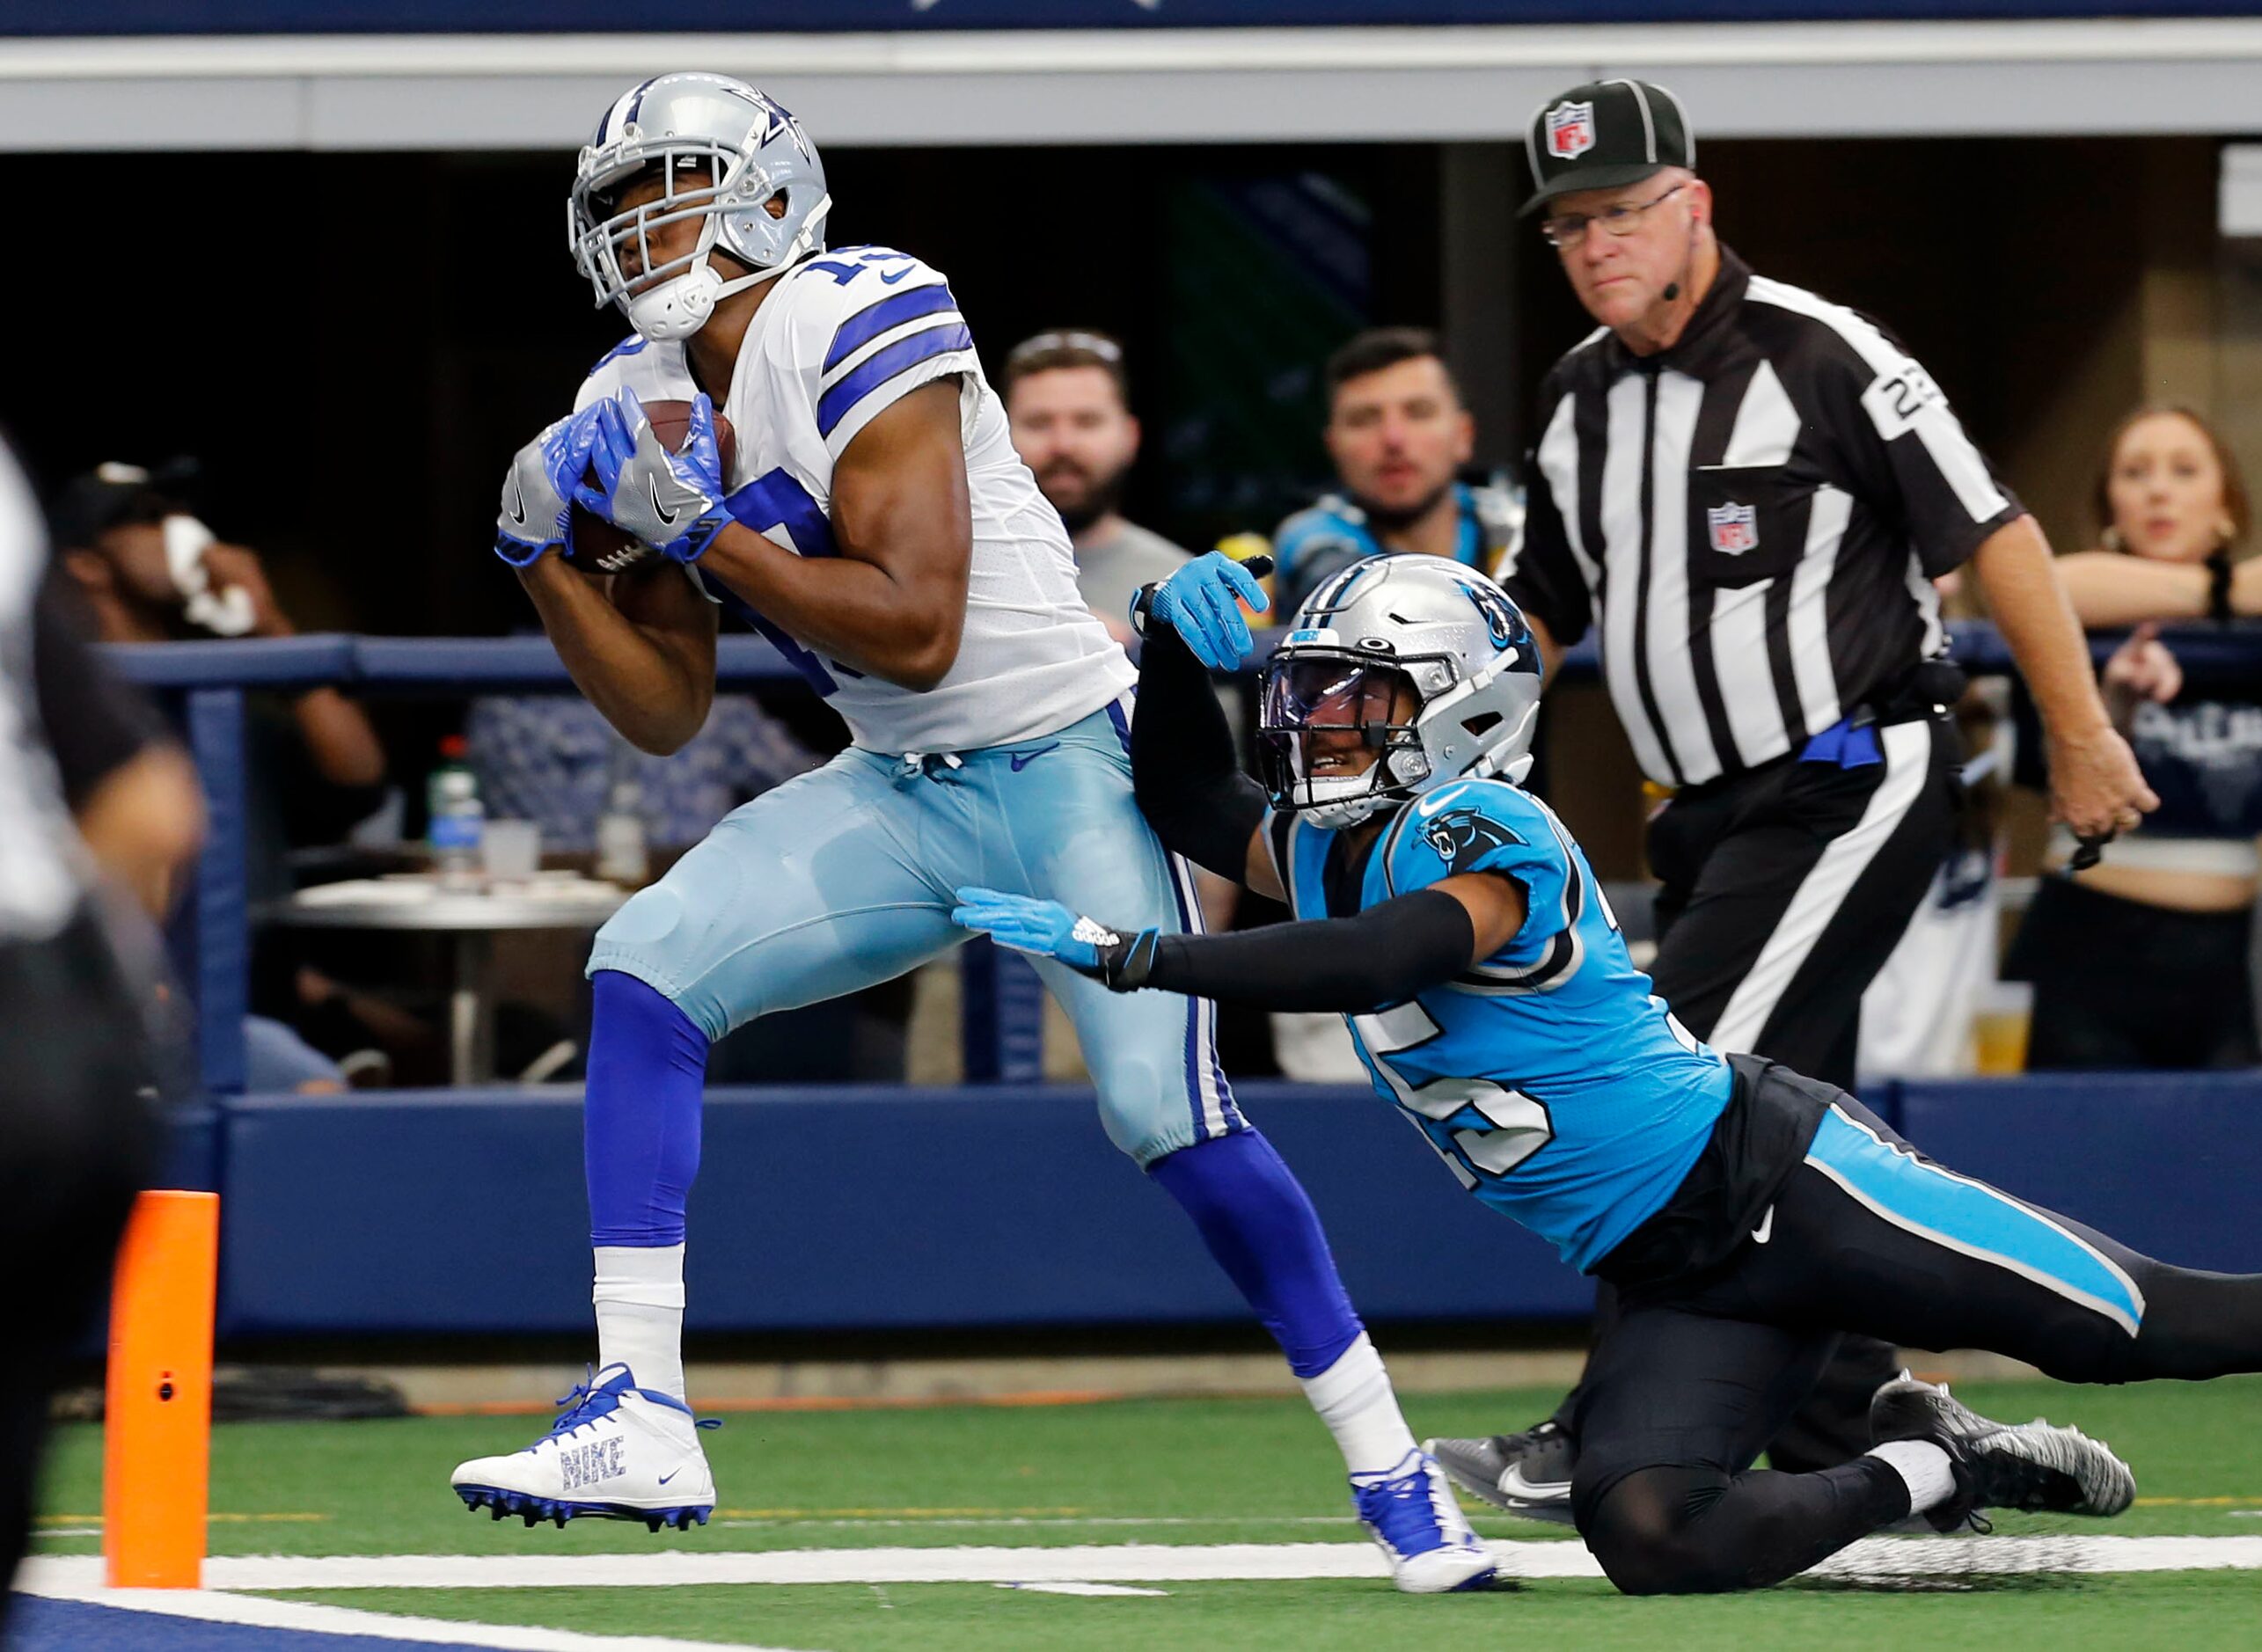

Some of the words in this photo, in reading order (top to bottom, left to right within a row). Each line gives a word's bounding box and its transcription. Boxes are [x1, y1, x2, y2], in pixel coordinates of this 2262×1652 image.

[1554, 125, 1589, 151] NFL
[1717, 523, 1753, 549] NFL
[560, 1436, 626, 1491] NIKE
